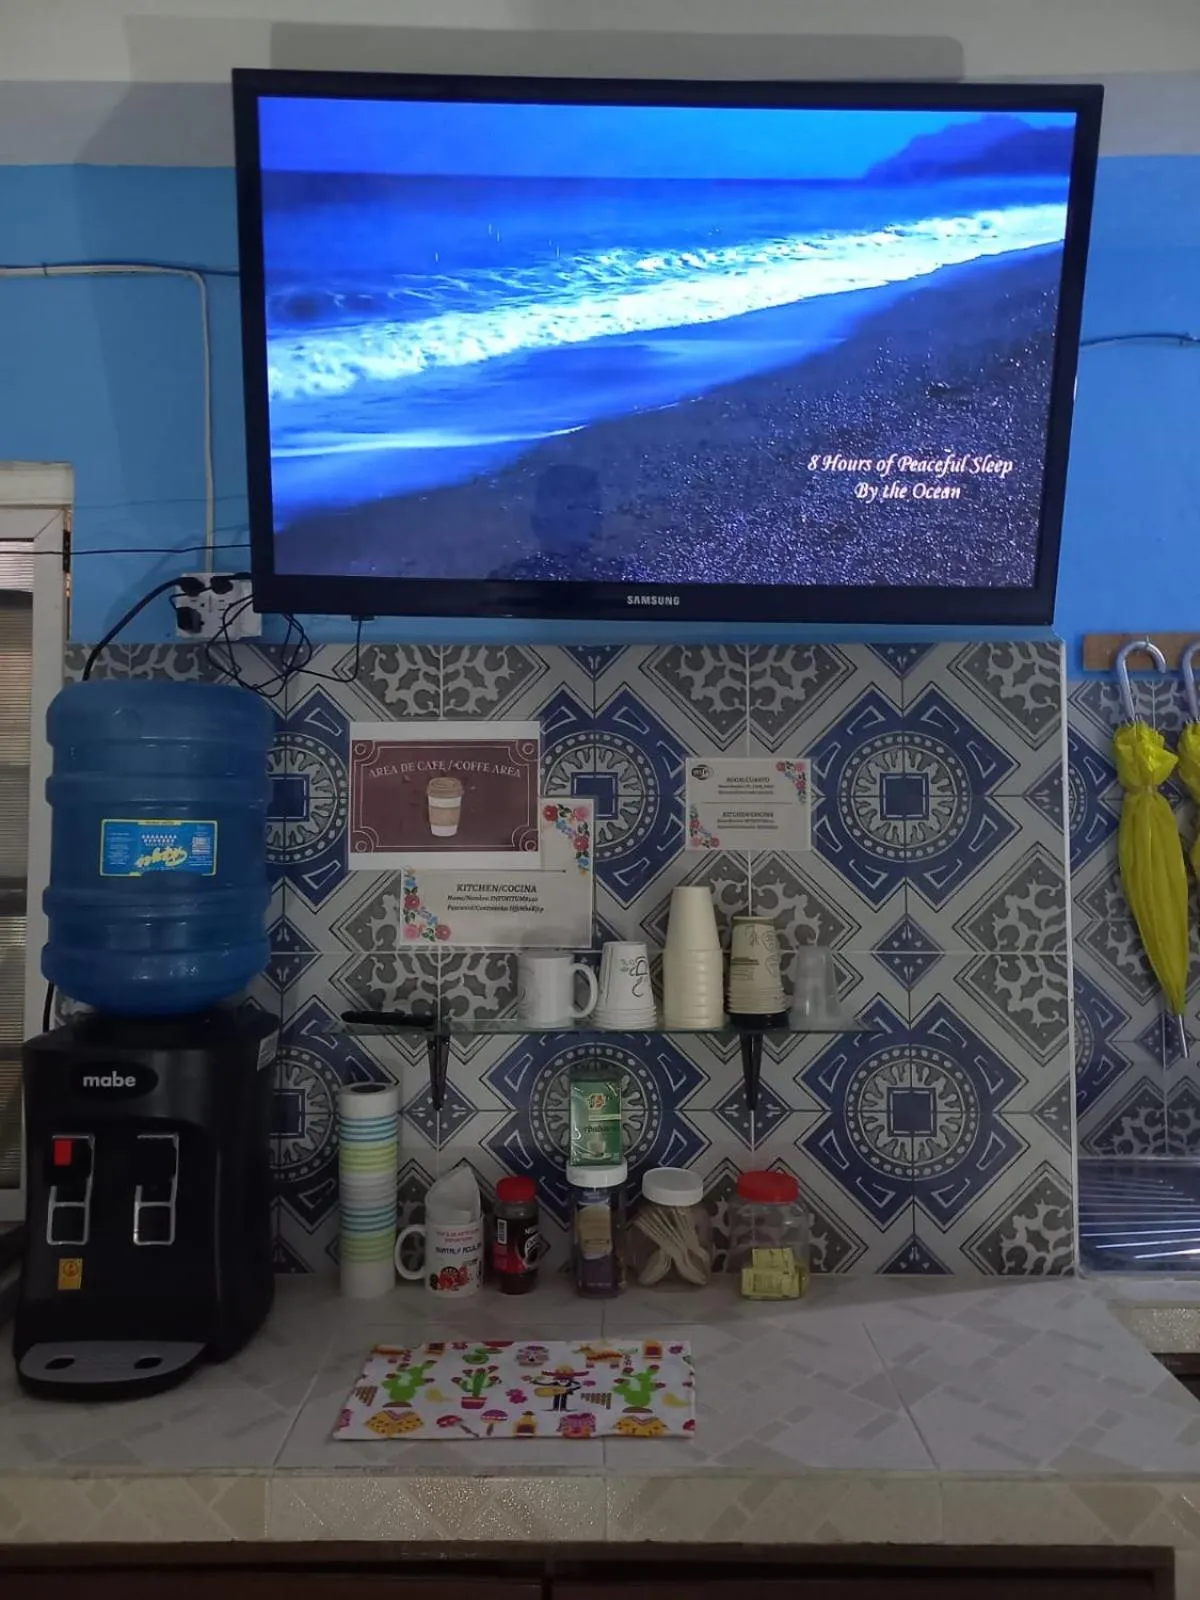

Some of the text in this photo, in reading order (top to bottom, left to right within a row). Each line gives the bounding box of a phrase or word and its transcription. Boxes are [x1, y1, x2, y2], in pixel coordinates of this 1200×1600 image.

[807, 453, 1013, 479] 8 Hours of Peaceful Sleep
[855, 480, 961, 503] By the Ocean
[626, 595, 680, 606] SAMSUNG
[368, 765, 398, 778] AREA
[401, 760, 415, 773] DE
[492, 764, 521, 778] AREA
[456, 883, 537, 893] KITCHEN/COCINA
[82, 1070, 136, 1087] mabe
